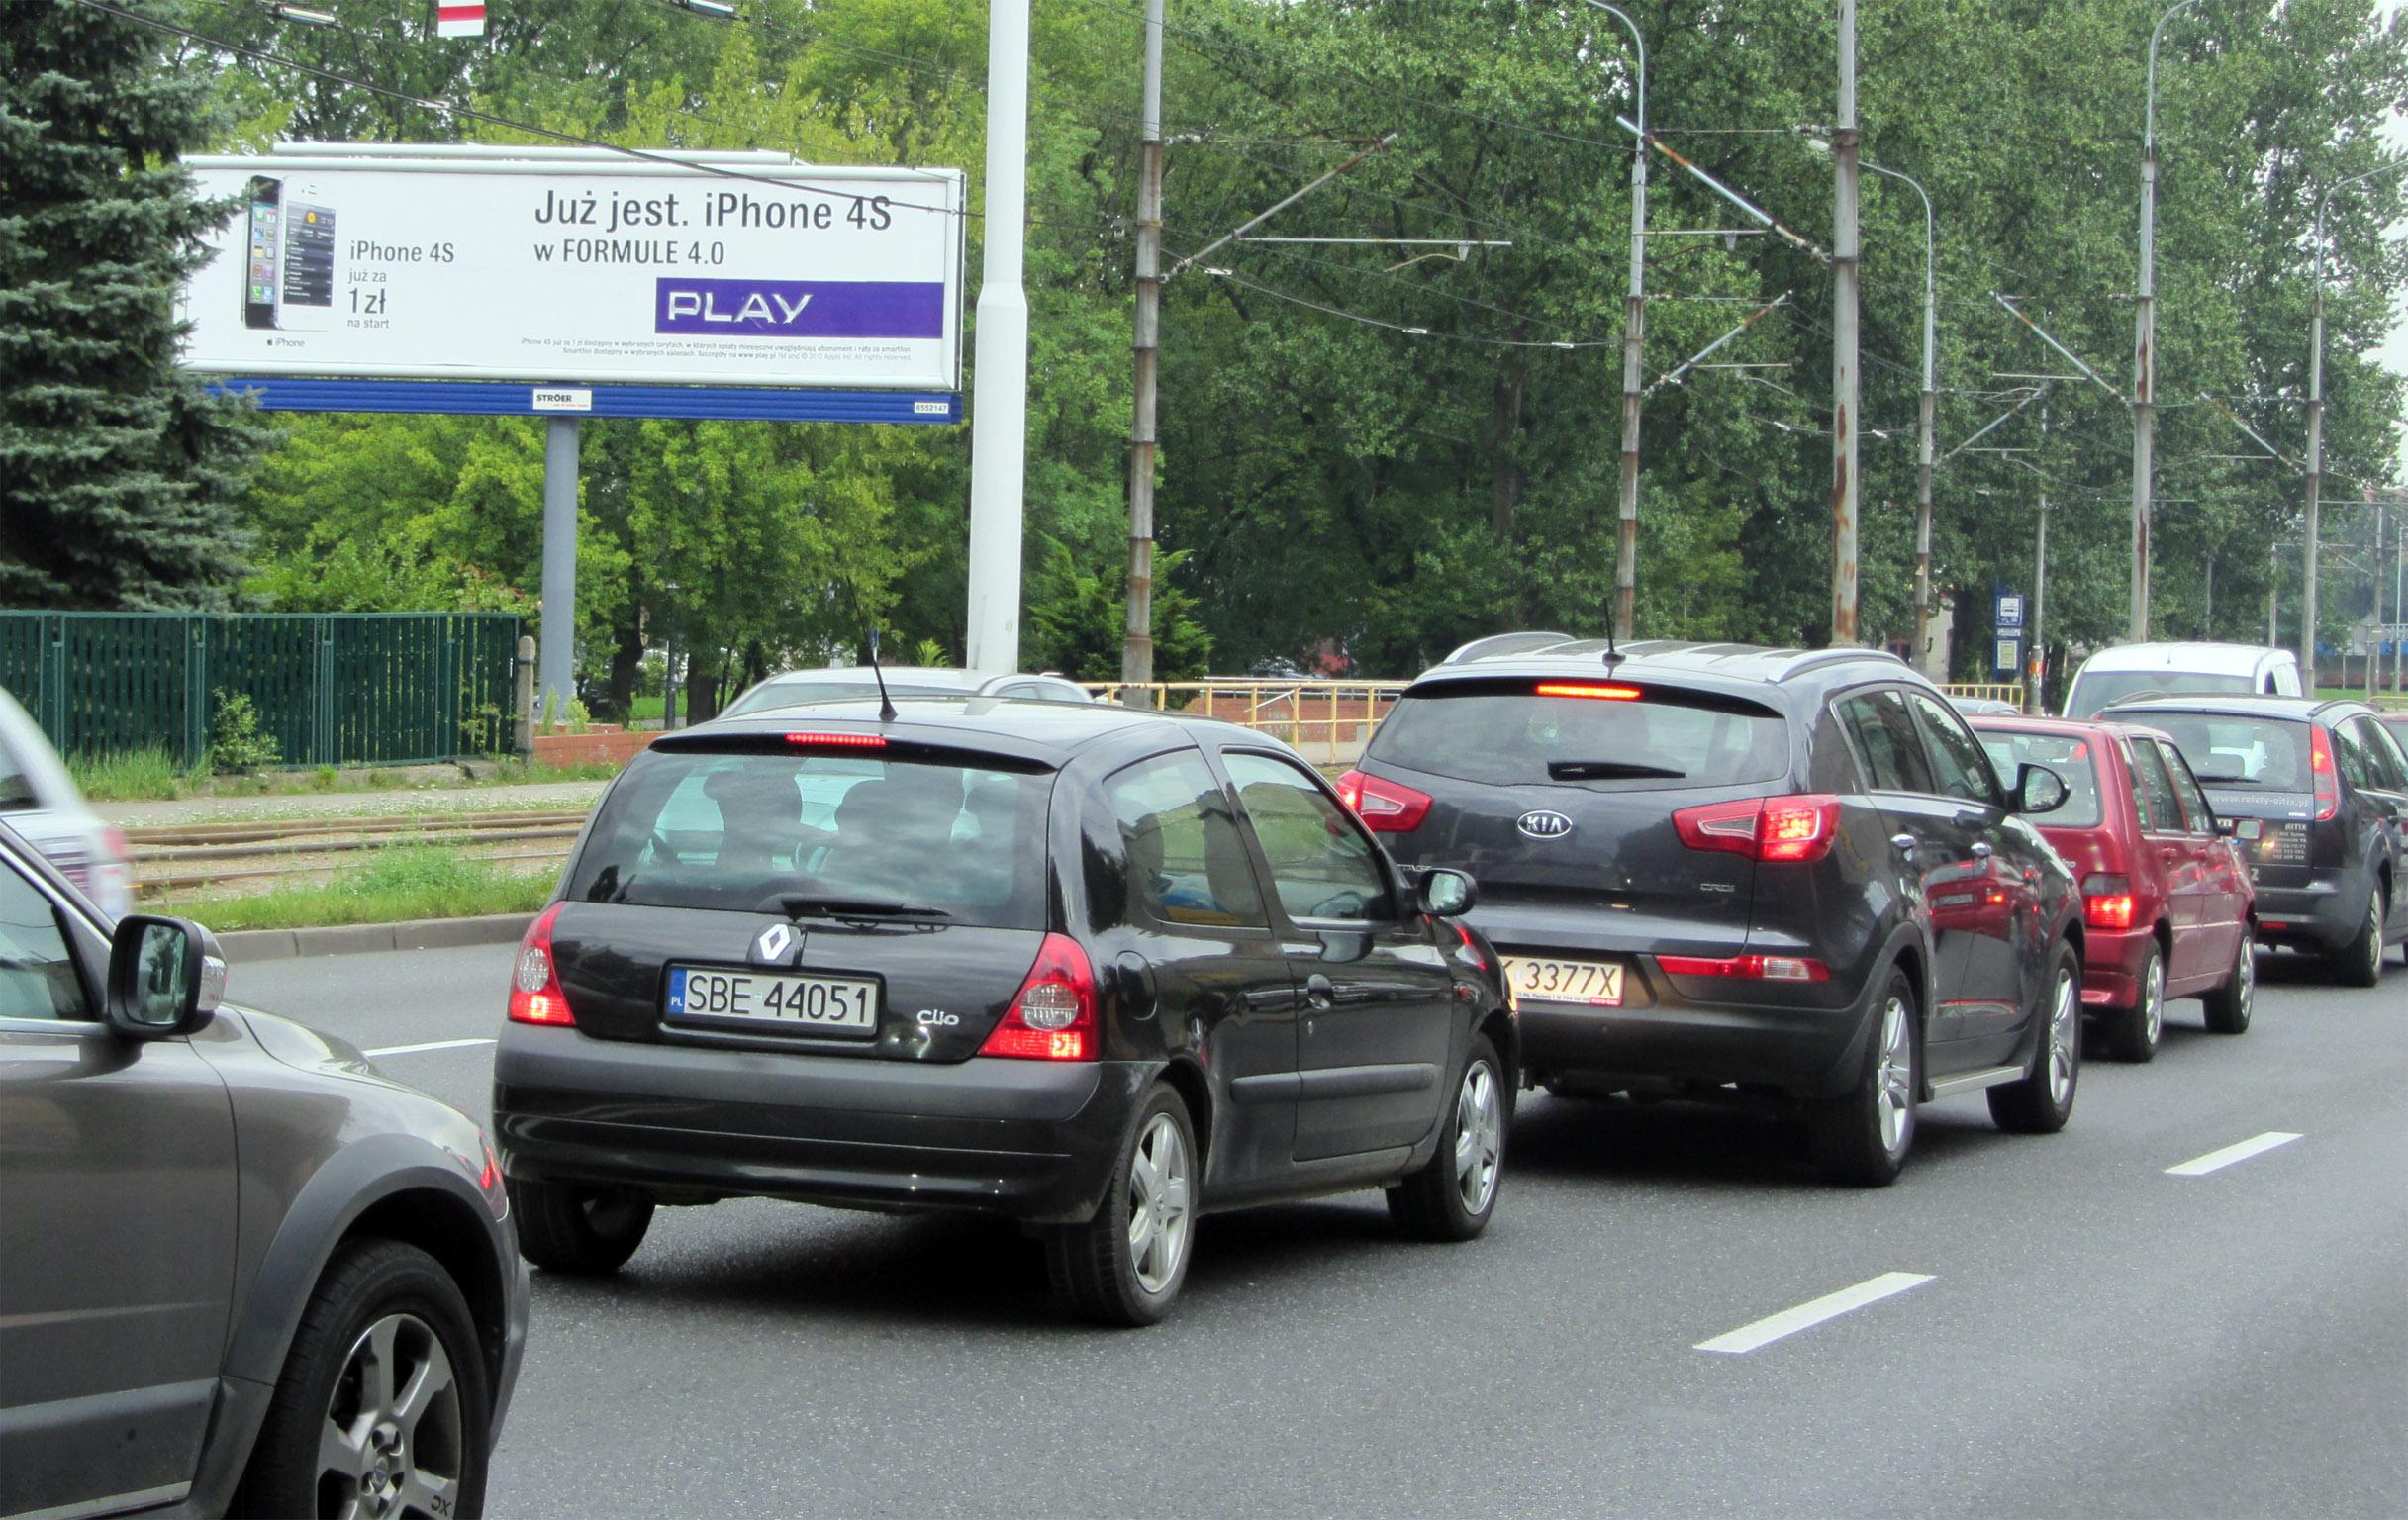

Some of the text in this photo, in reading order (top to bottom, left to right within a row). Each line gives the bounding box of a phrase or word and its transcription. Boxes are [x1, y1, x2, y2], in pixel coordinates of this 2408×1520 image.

[535, 190, 891, 233] Już jest. iPhone 4S
[350, 240, 454, 263] iPhone 4S
[534, 238, 724, 265] w FORMULE 4.0
[348, 268, 387, 285] już za
[349, 287, 386, 315] 1 zł
[668, 291, 813, 324] PLAY
[347, 318, 390, 329] na start
[275, 337, 305, 348] iPhone
[1526, 815, 1562, 833] KIA
[671, 997, 683, 1007] PL
[688, 974, 867, 1023] SBE 44051
[916, 1008, 960, 1026] Clio
